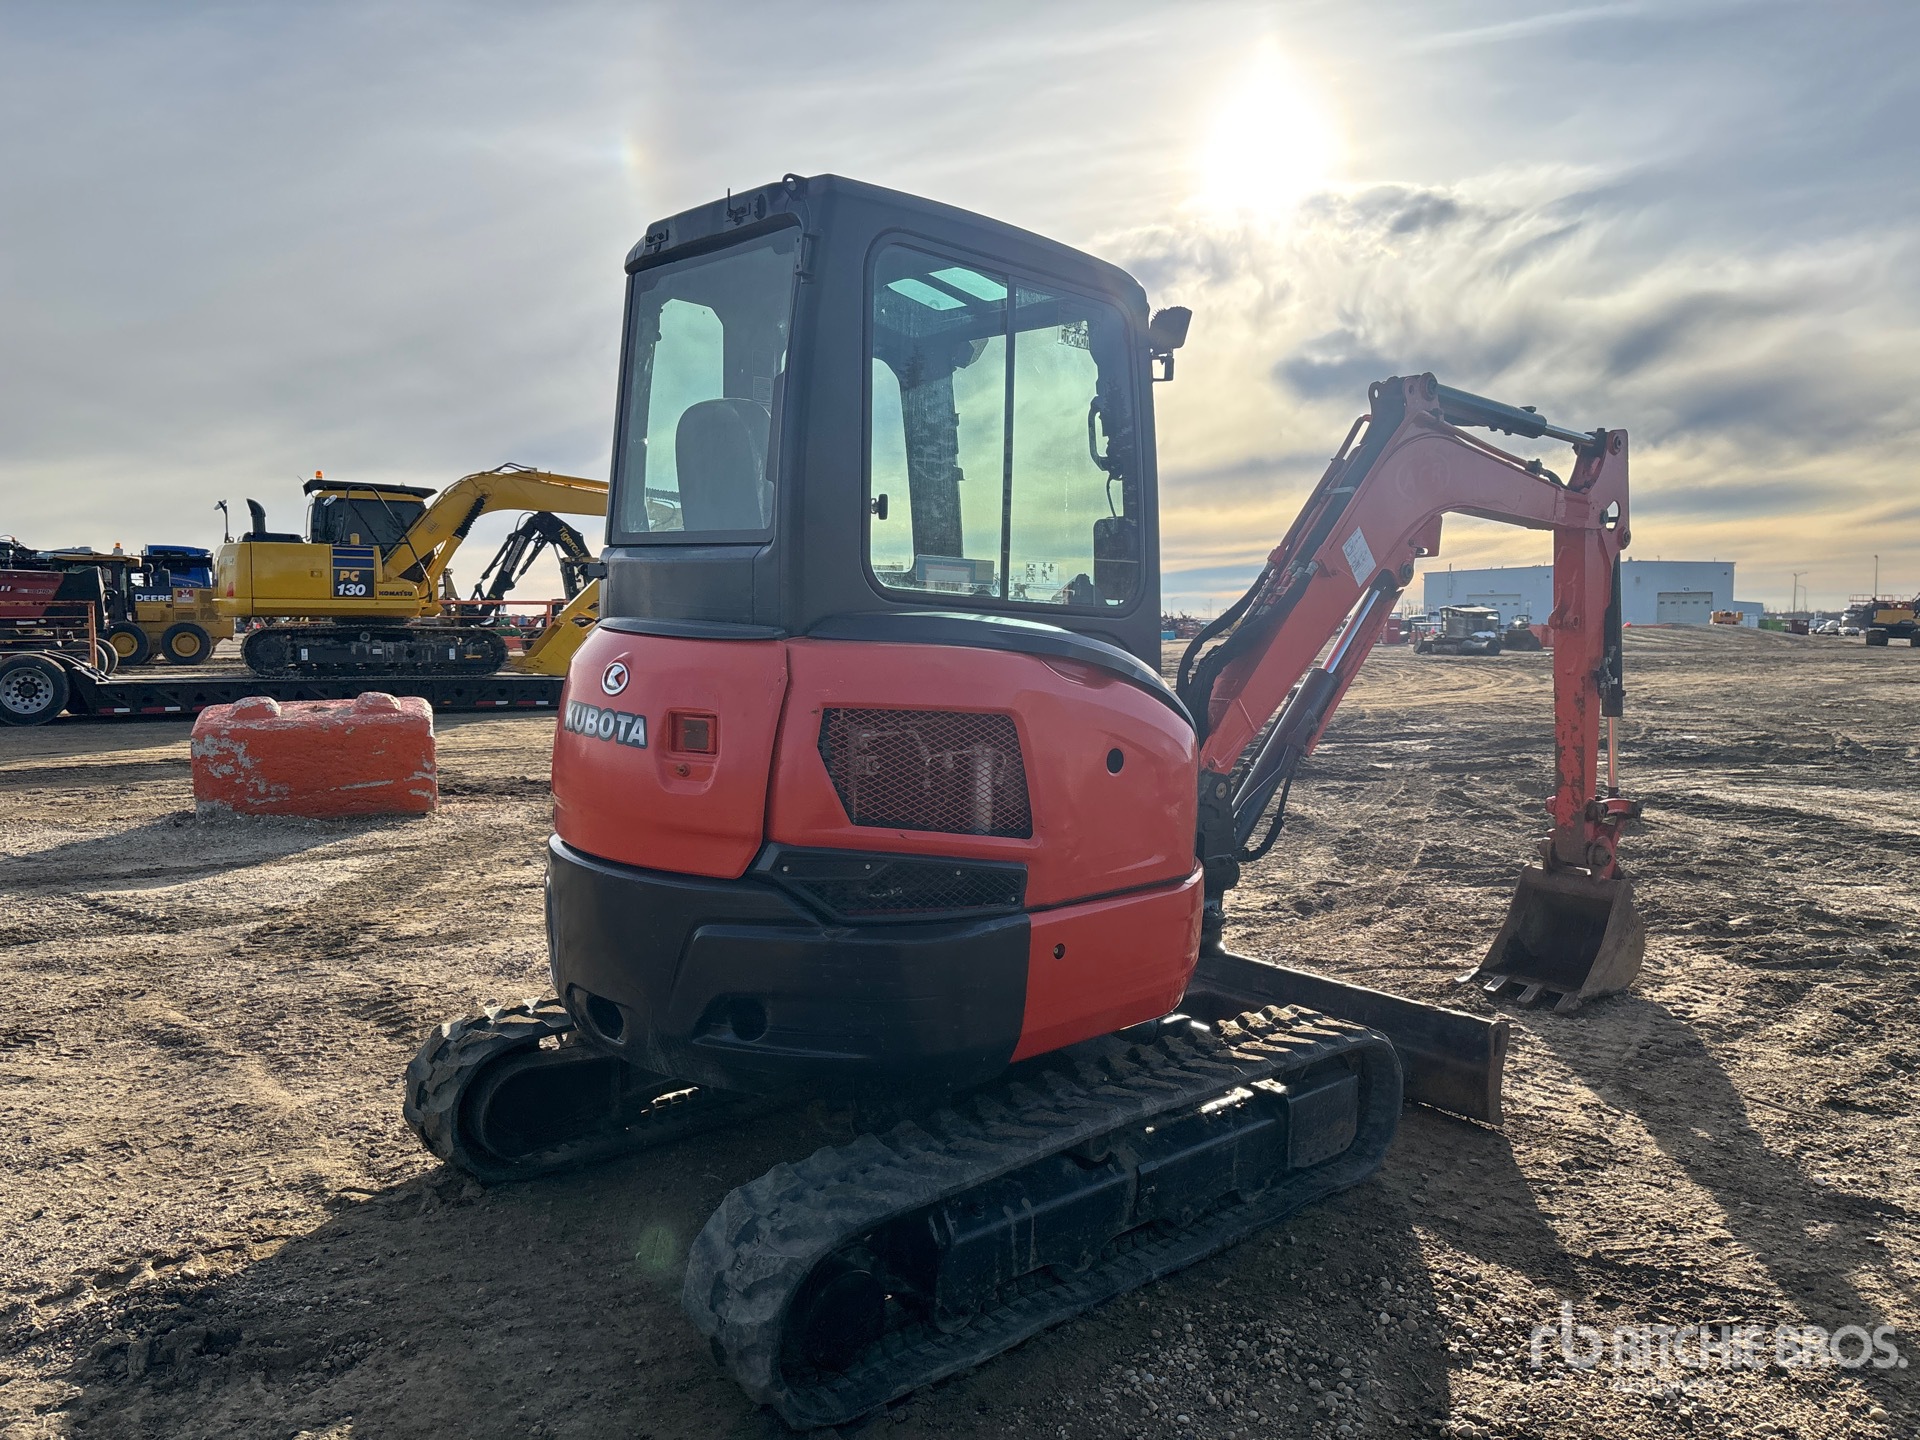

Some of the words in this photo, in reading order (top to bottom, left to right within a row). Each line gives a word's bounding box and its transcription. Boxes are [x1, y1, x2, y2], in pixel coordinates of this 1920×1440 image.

[338, 570, 360, 582] PC
[337, 583, 367, 596] 130
[134, 593, 173, 602] DEERE
[564, 700, 646, 747] KUBOTA
